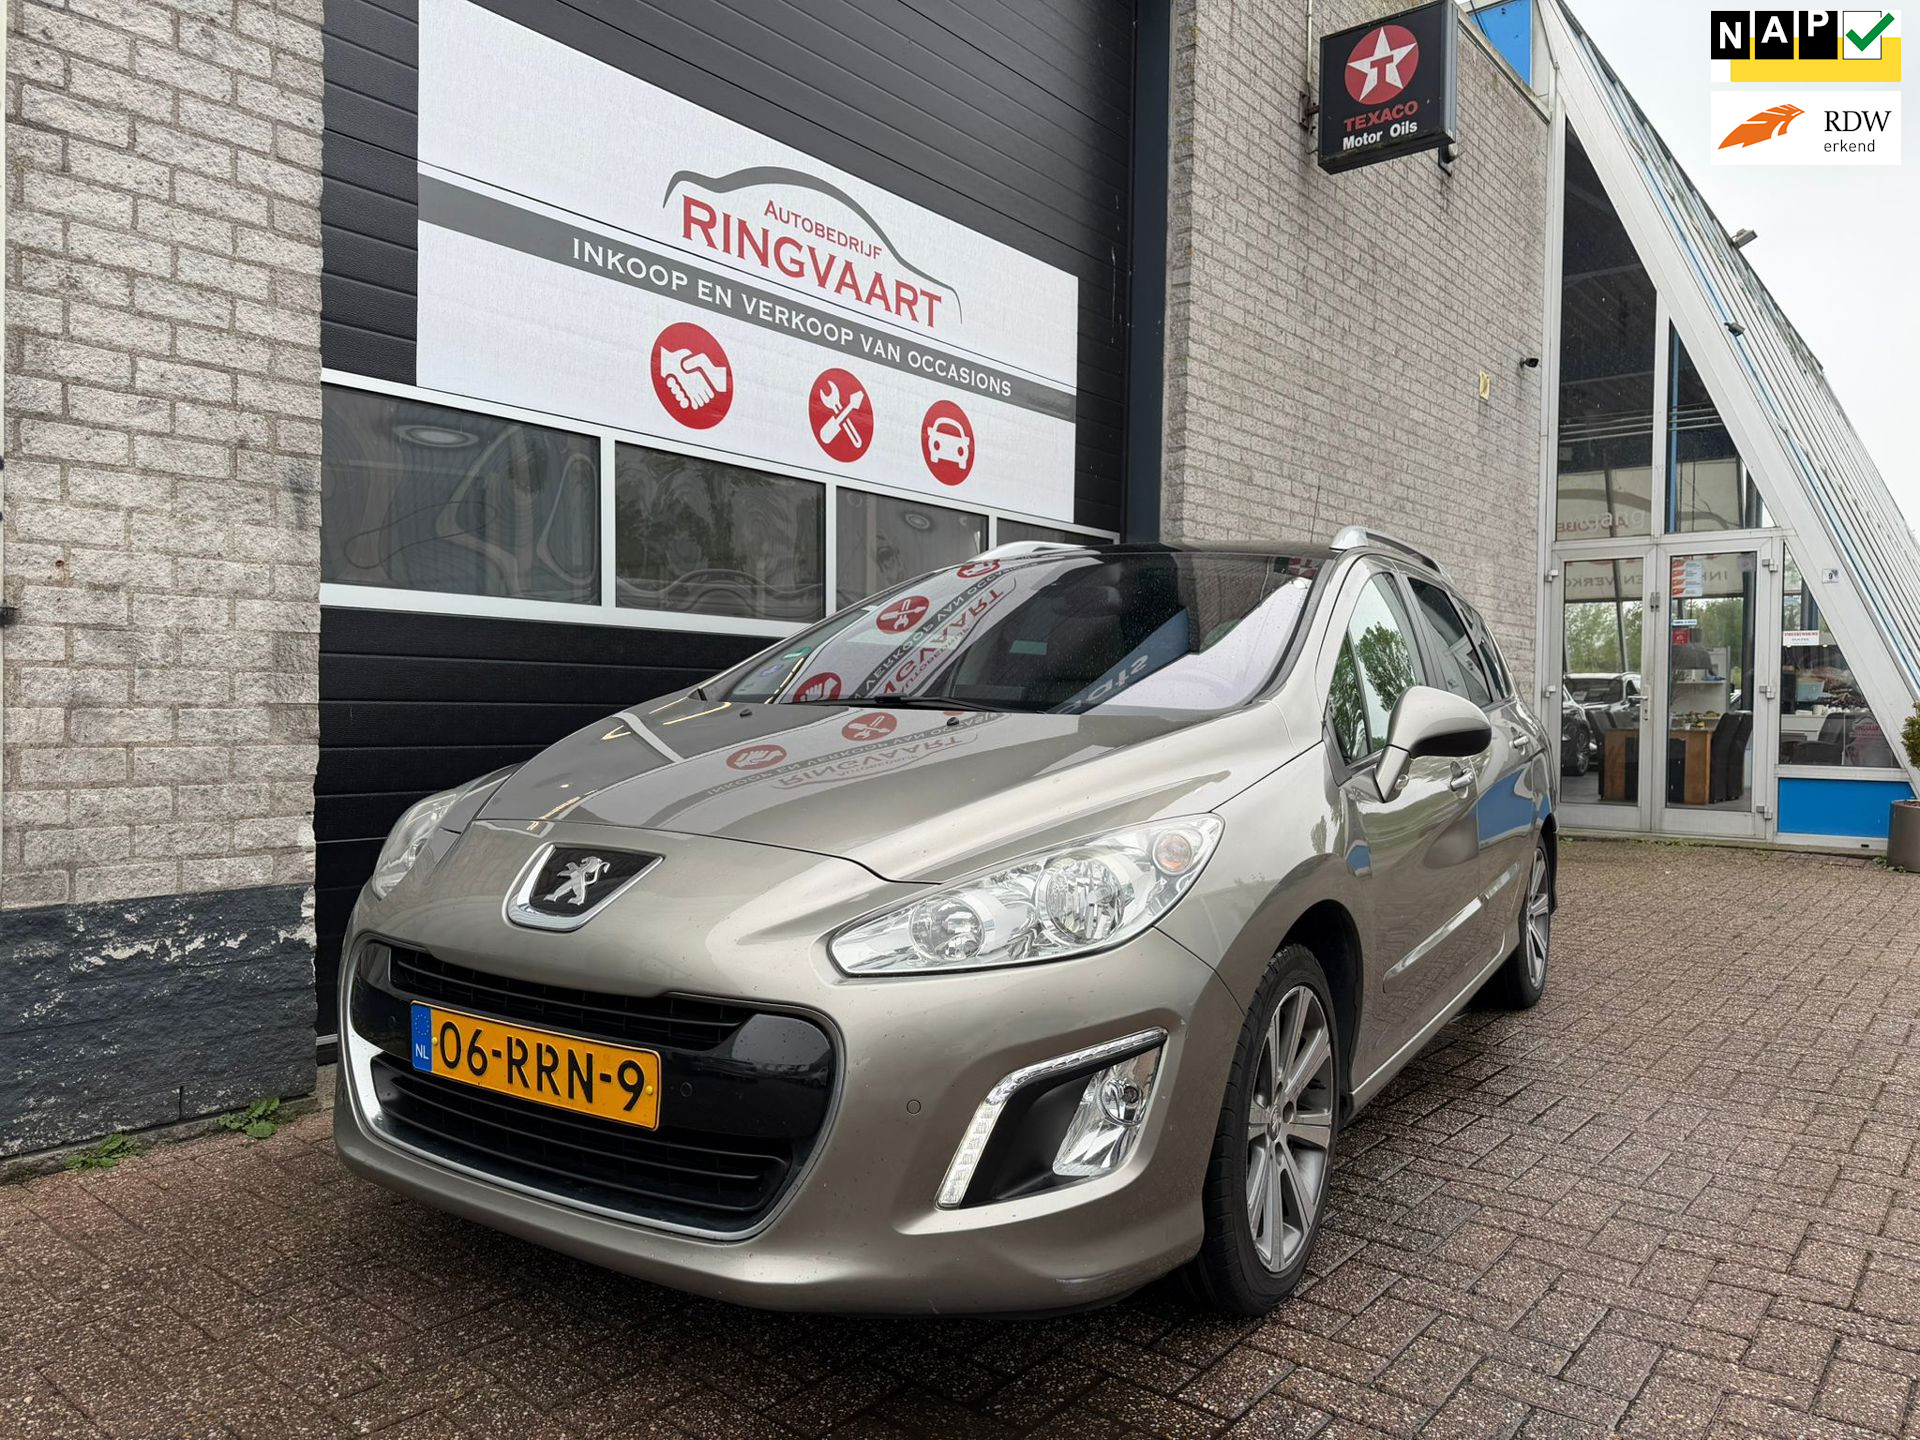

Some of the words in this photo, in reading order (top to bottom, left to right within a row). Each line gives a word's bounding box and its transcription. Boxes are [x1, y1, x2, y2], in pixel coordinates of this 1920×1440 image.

[1342, 130, 1383, 151] Motor
[1389, 120, 1418, 138] Oils
[1344, 100, 1419, 132] TEXACO
[682, 194, 942, 328] RINGVAART
[764, 200, 882, 260] AUTOBEDRIJF
[573, 238, 688, 291] INKOOP
[697, 279, 732, 308] EN
[742, 293, 853, 345] VERKOOP
[860, 334, 900, 363] VAN
[907, 351, 1012, 397] OCCASIONS
[415, 1043, 429, 1061] NL
[440, 1021, 645, 1112] 06-RRN-9
